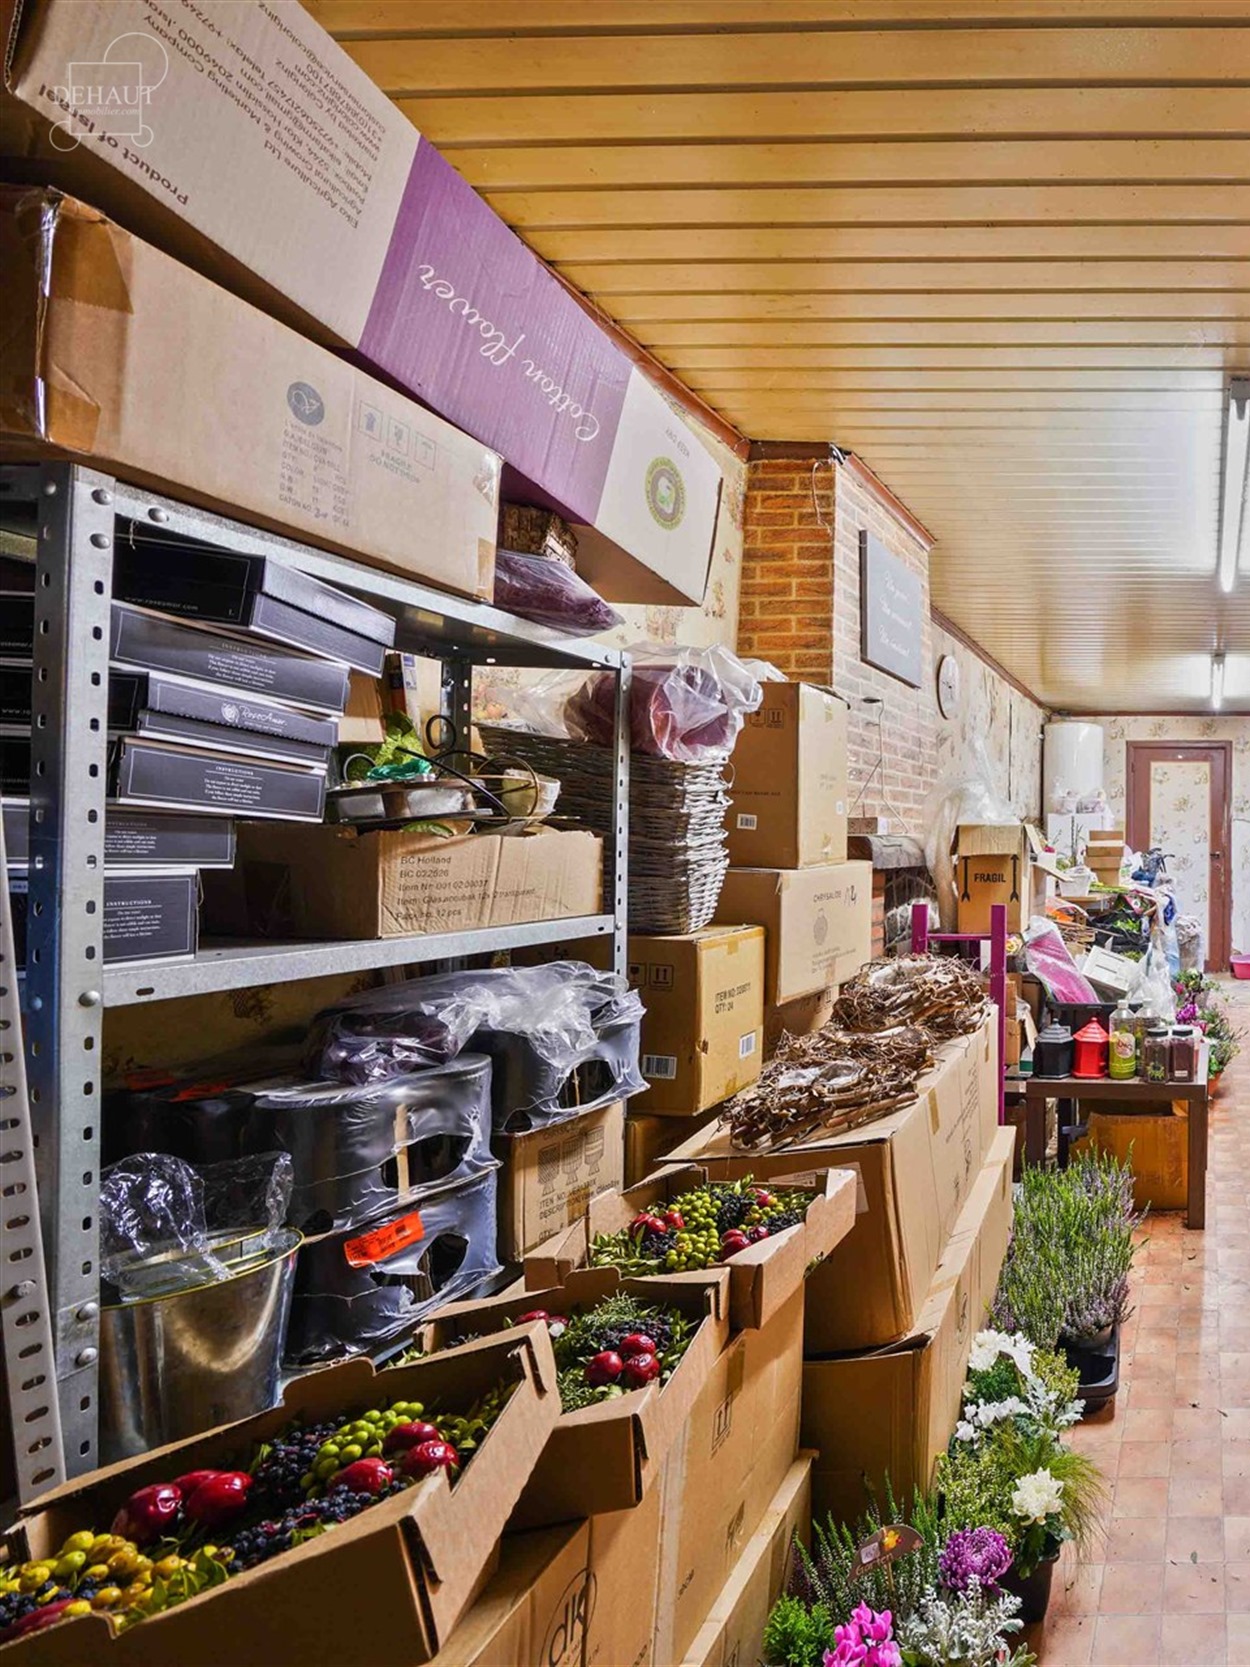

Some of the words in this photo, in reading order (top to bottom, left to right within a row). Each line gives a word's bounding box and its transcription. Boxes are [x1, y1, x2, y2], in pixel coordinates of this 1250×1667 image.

[143, 10, 205, 75] Company
[177, 25, 233, 84] 2049000
[37, 83, 95, 133] Israel
[206, 68, 261, 126] Marketing
[97, 130, 119, 149] of
[263, 121, 271, 135] &
[263, 138, 281, 161] Ltd
[273, 129, 313, 173] Growing
[121, 147, 188, 204] Product
[283, 154, 338, 211] Agriculture
[314, 166, 362, 216] Agricultural
[522, 359, 600, 441] Cotton
[417, 856, 452, 865] Holland
[974, 872, 1007, 883] FRAGIL
